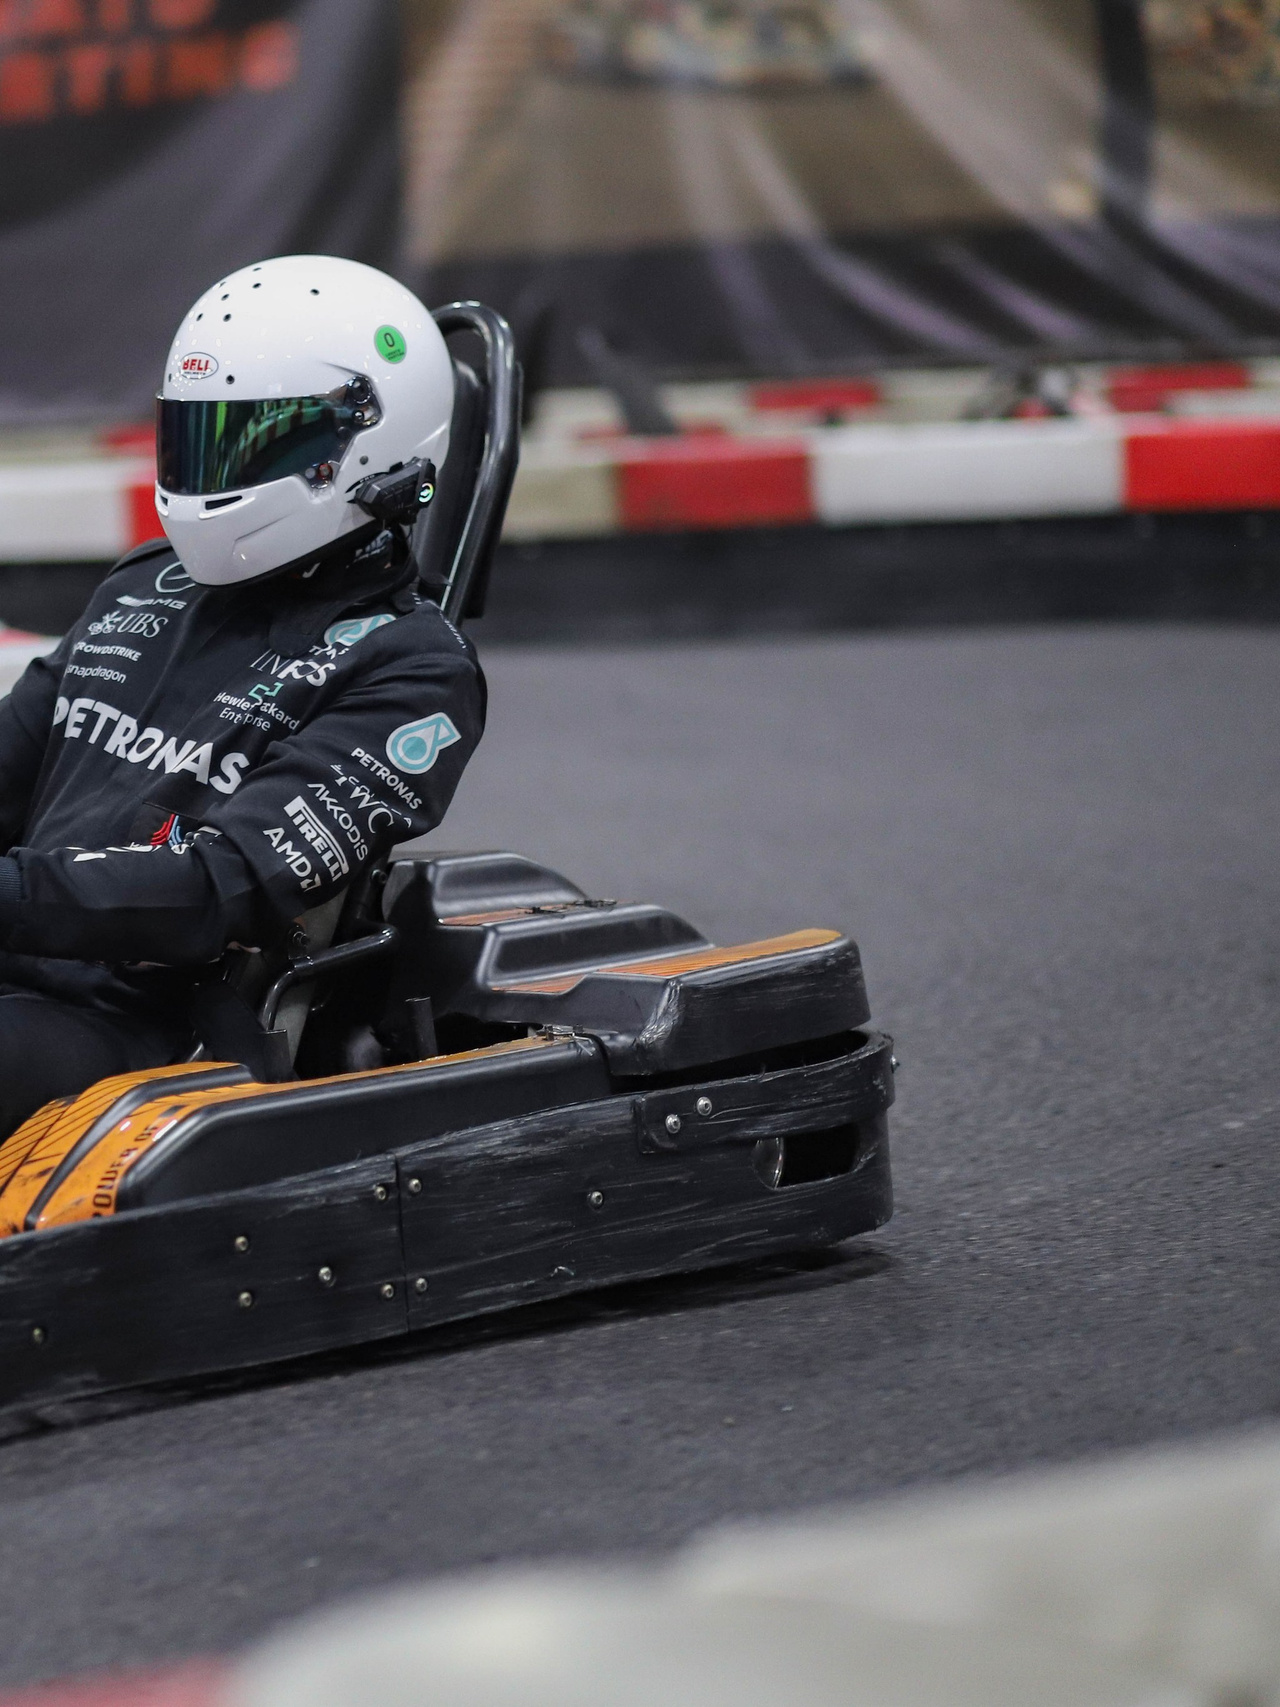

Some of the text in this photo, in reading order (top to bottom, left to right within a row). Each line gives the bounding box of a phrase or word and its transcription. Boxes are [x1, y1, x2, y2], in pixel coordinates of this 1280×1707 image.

[139, 598, 188, 610] AMG
[117, 612, 169, 638] UBS
[66, 664, 127, 683] snapdragon
[214, 692, 255, 711] Hewle
[219, 707, 271, 732] Entprse
[53, 696, 250, 795] PETRONAS
[351, 747, 422, 810] PETRONAS
[283, 795, 350, 882] PIRELLI
[263, 827, 313, 878] AMD
